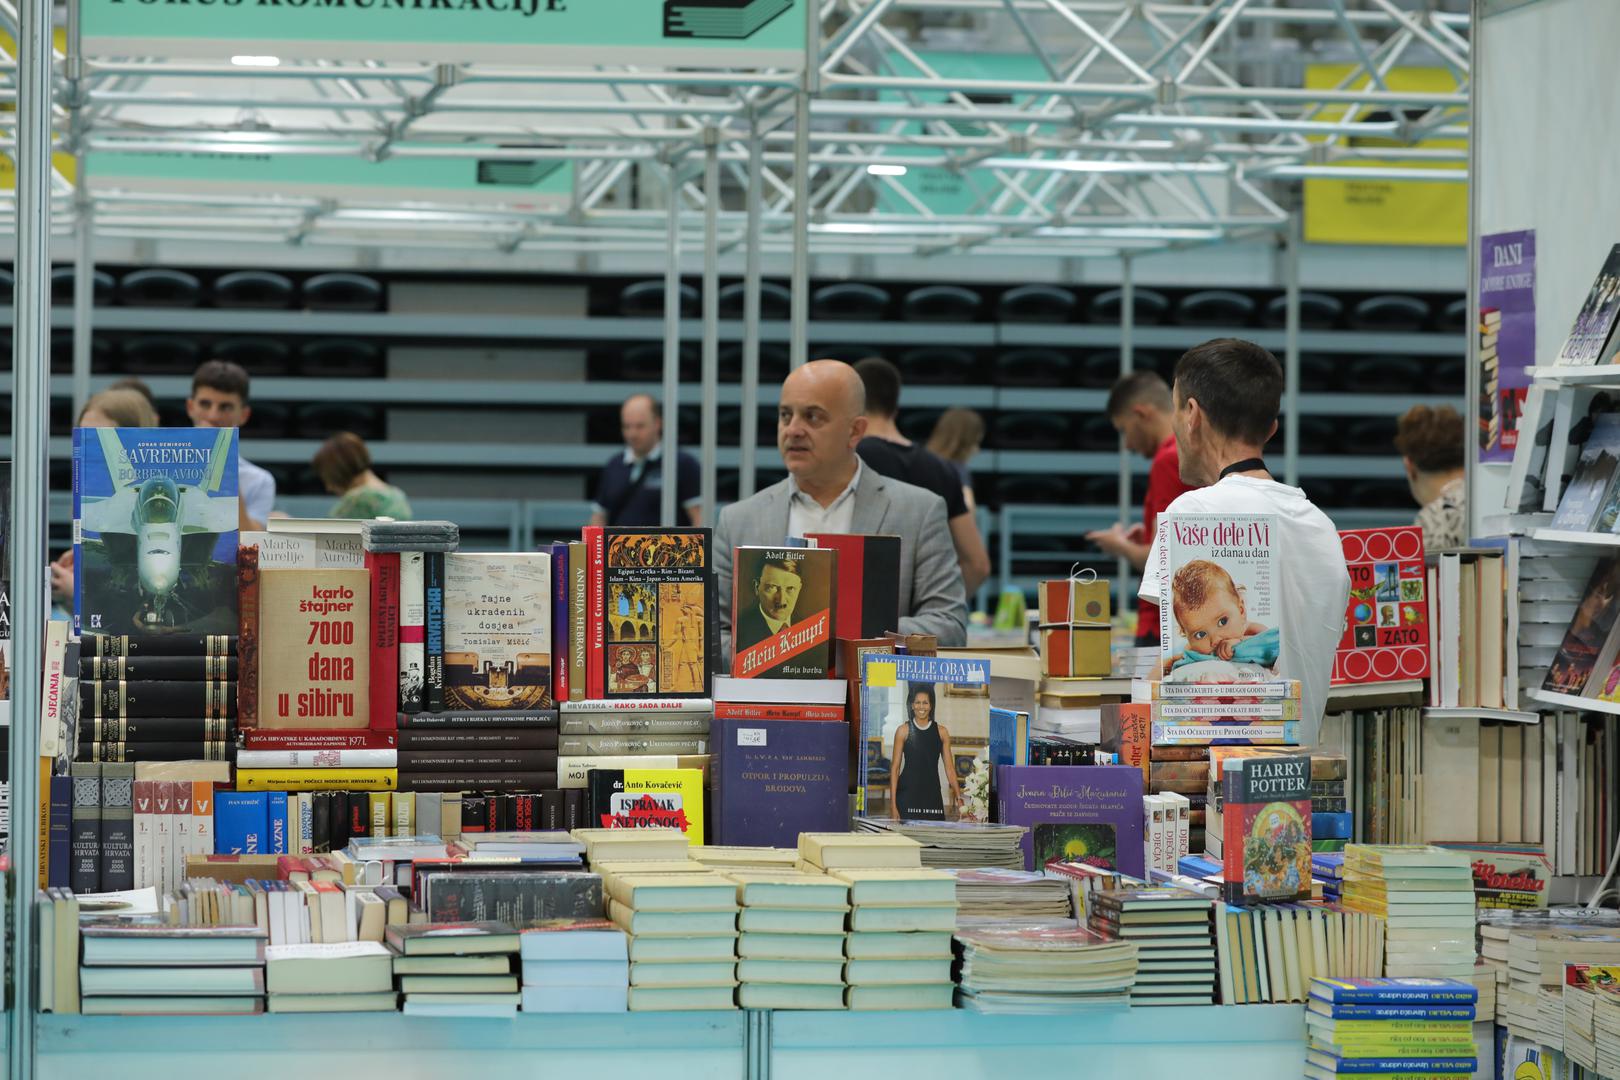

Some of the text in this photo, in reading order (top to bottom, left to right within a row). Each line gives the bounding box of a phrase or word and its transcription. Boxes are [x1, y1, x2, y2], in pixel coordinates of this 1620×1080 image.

[1494, 242, 1522, 267] DANI
[118, 448, 212, 464] SAVREMENI
[118, 468, 212, 481] BORBENI AVIONI
[1159, 520, 1169, 542] Vaše
[1173, 521, 1270, 546] Vaše dete i Vi
[263, 538, 300, 550] Marko
[325, 539, 362, 550] Marko
[259, 551, 304, 563] Aurelije
[765, 551, 805, 560] Adolf Hitler
[1159, 545, 1168, 566] dete
[1211, 547, 1270, 558] iz dana u dan
[646, 575, 661, 583] Japan
[312, 585, 354, 599] karlo
[481, 594, 512, 604] Tajne
[299, 600, 354, 615] štajner
[467, 608, 525, 616] ukradenih
[1161, 599, 1170, 623] dana
[427, 587, 442, 655] HRVATSKA
[575, 567, 585, 667] ANDRIJA HEBRANG
[307, 621, 354, 645] 7000
[479, 621, 514, 631] dosjea
[464, 637, 530, 646] Tomislav Mičić
[1162, 633, 1171, 651] dan
[1384, 628, 1419, 645] ZATO
[742, 616, 826, 674] Mein Kampf
[308, 652, 354, 681] dana
[428, 656, 436, 684] Bogdan
[782, 665, 822, 675] Moja borba
[939, 661, 985, 676] OBAMA
[48, 672, 60, 718] SJEĆANJA
[278, 688, 354, 717] u sibiru
[1167, 728, 1178, 736] ŠTA
[1186, 728, 1218, 736] OČEKUJETE
[1223, 728, 1241, 736] PRVOJ
[348, 736, 367, 746] 1971.
[1129, 745, 1142, 767] otter
[568, 772, 585, 780] MOJ
[779, 773, 831, 781] PROPULZIJA
[1251, 762, 1304, 778] HARRY
[613, 781, 624, 789] dr.
[645, 780, 683, 789] Kovačević
[765, 785, 806, 793] BRODOVA
[1250, 778, 1306, 793] POTTER
[620, 799, 675, 810] ISPRAVAK
[39, 802, 47, 836] RUBIKON
[615, 812, 680, 828] NETOČNOG
[140, 822, 148, 832] 1.
[159, 822, 168, 832] 1.
[179, 822, 187, 832] 1.
[198, 823, 207, 833] 2.
[273, 819, 283, 854] KAZNE
